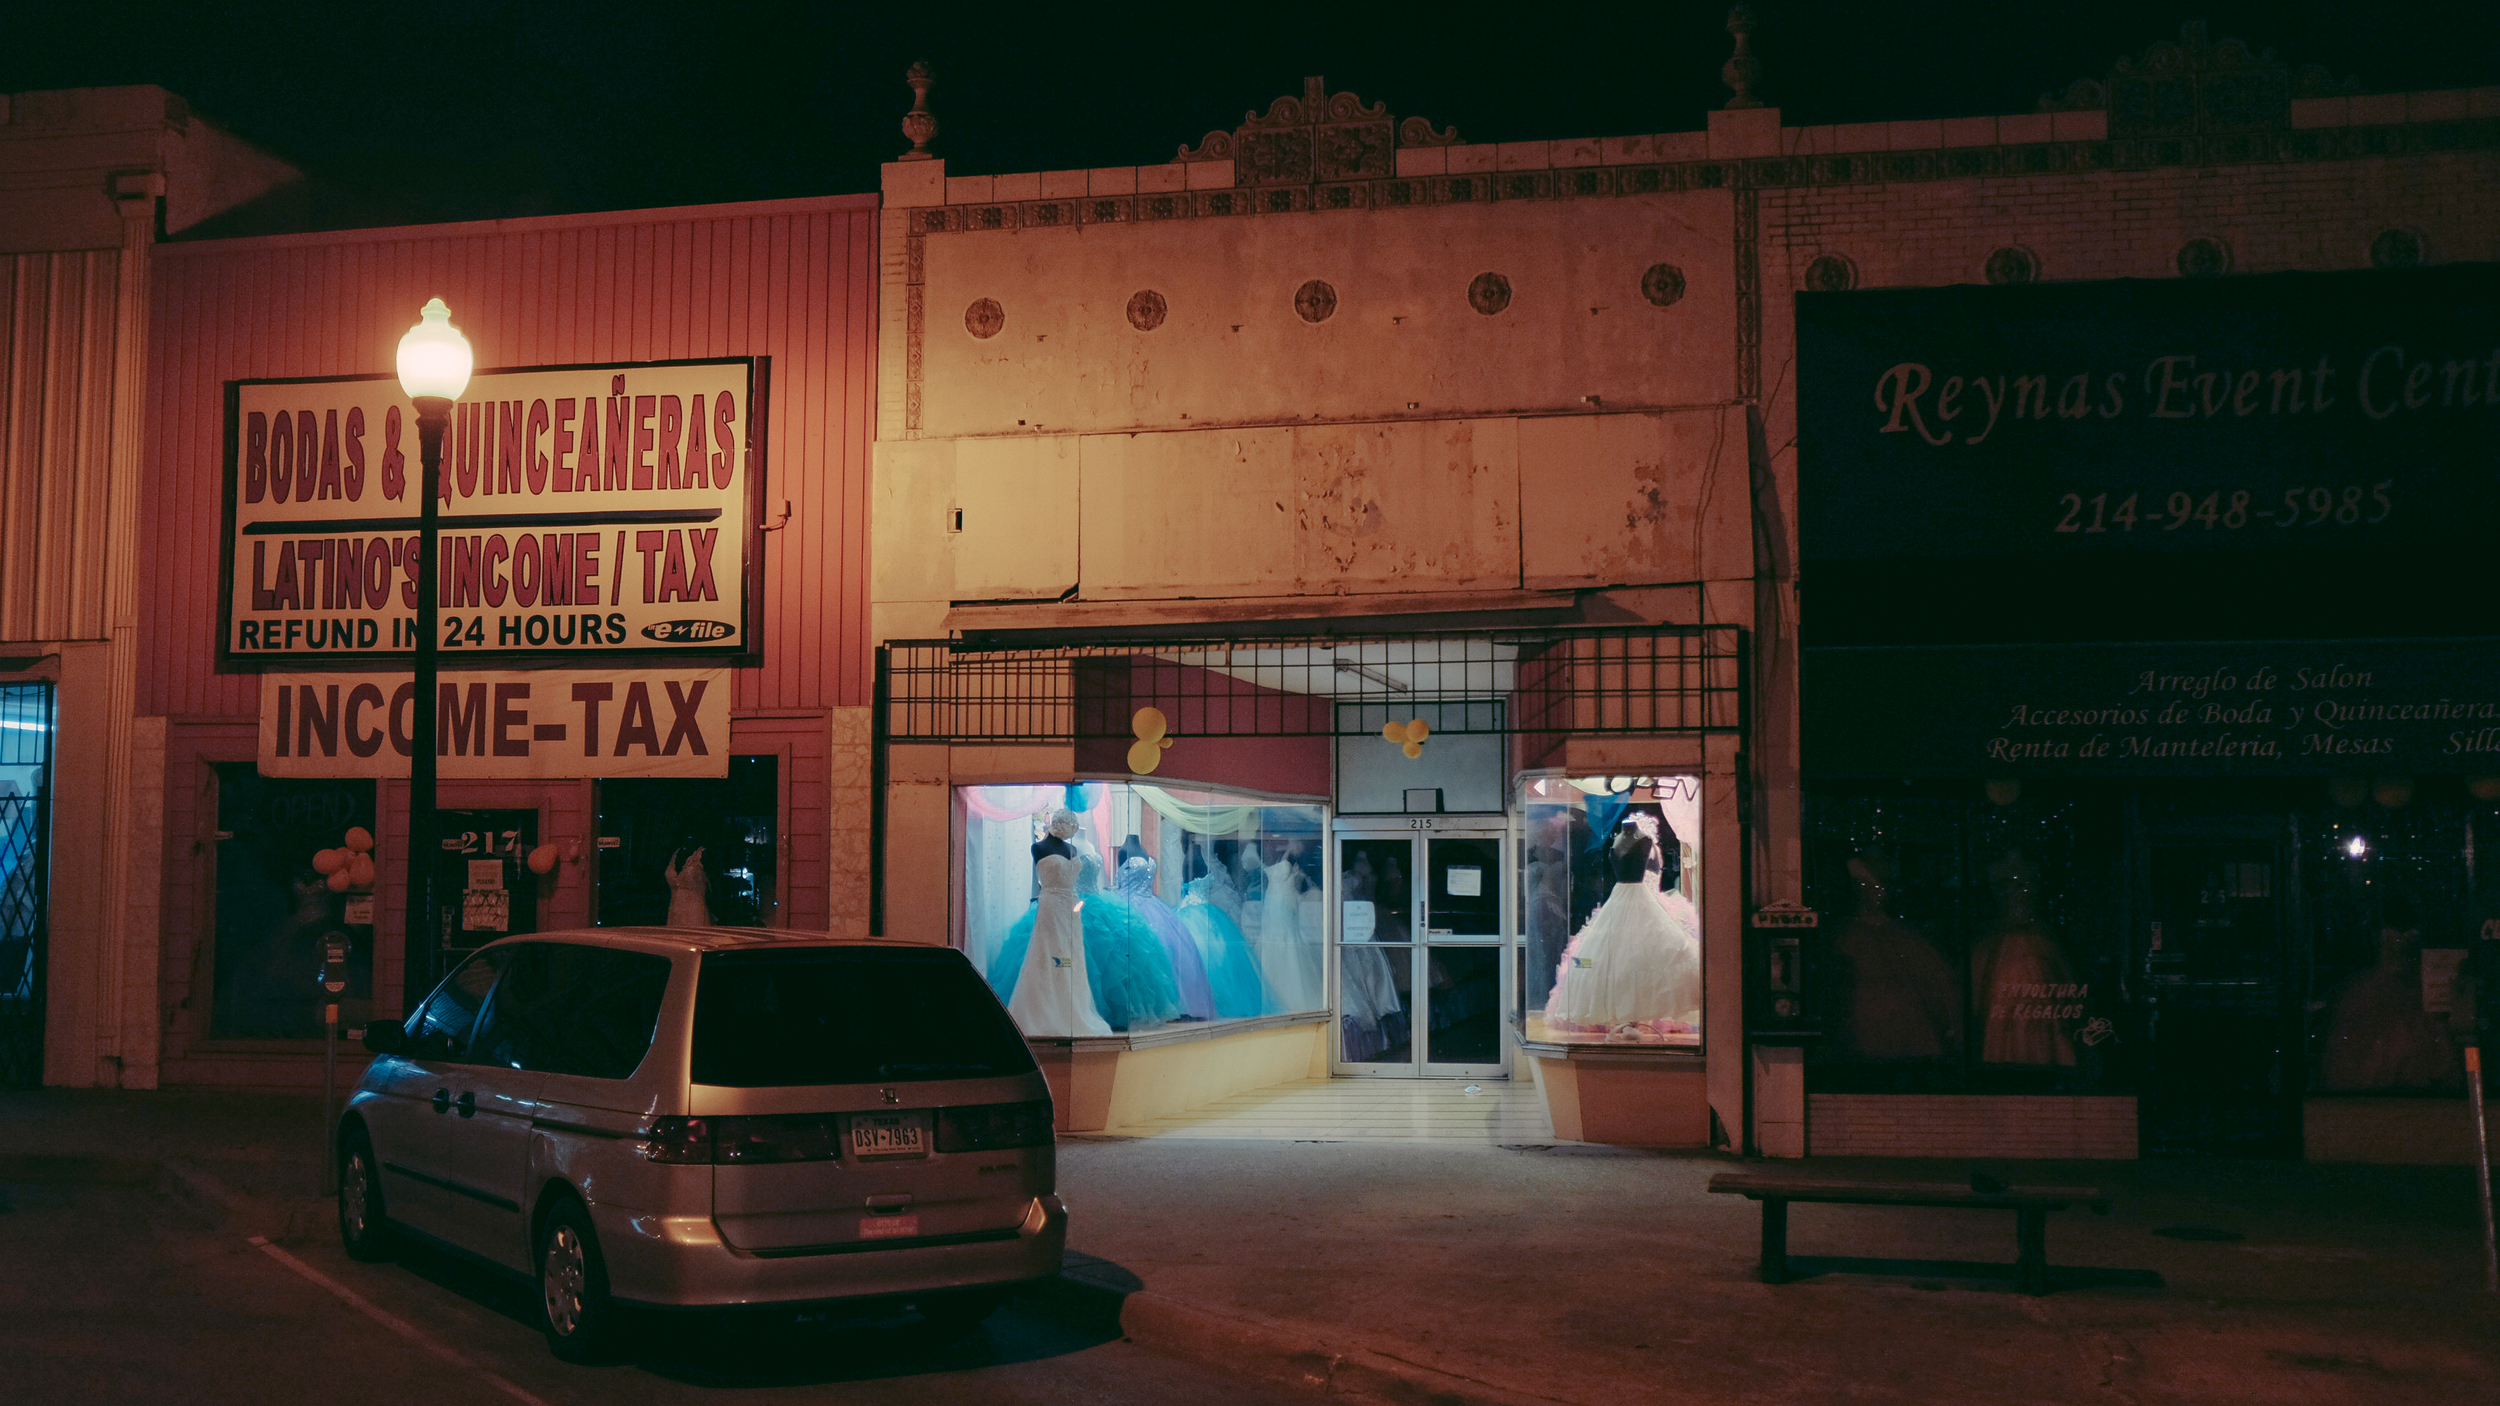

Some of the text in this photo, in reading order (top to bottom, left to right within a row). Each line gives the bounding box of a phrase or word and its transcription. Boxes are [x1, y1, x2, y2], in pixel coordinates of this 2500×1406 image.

[1874, 362, 2125, 445] Reynas
[2144, 354, 2335, 421] Event
[245, 406, 365, 504] BODAS
[382, 405, 406, 502] &
[2054, 479, 2394, 533] 214-948-5985
[252, 536, 421, 611] LATINO'S
[439, 533, 600, 608] INCOME
[636, 528, 718, 603] TAX
[239, 617, 379, 650] REFUND
[443, 616, 485, 648] 24
[499, 612, 626, 646] HOURS
[2128, 664, 2372, 700] Arreglo de Salon
[276, 680, 709, 758] INCOME-TAX
[2001, 698, 2500, 729] Accesorios de Boda y Quinceañera
[1986, 736, 2069, 762] Renta
[2078, 734, 2110, 758] de
[2301, 732, 2394, 755] Mesas
[461, 830, 518, 854] 217
[1410, 819, 1432, 829] 215
